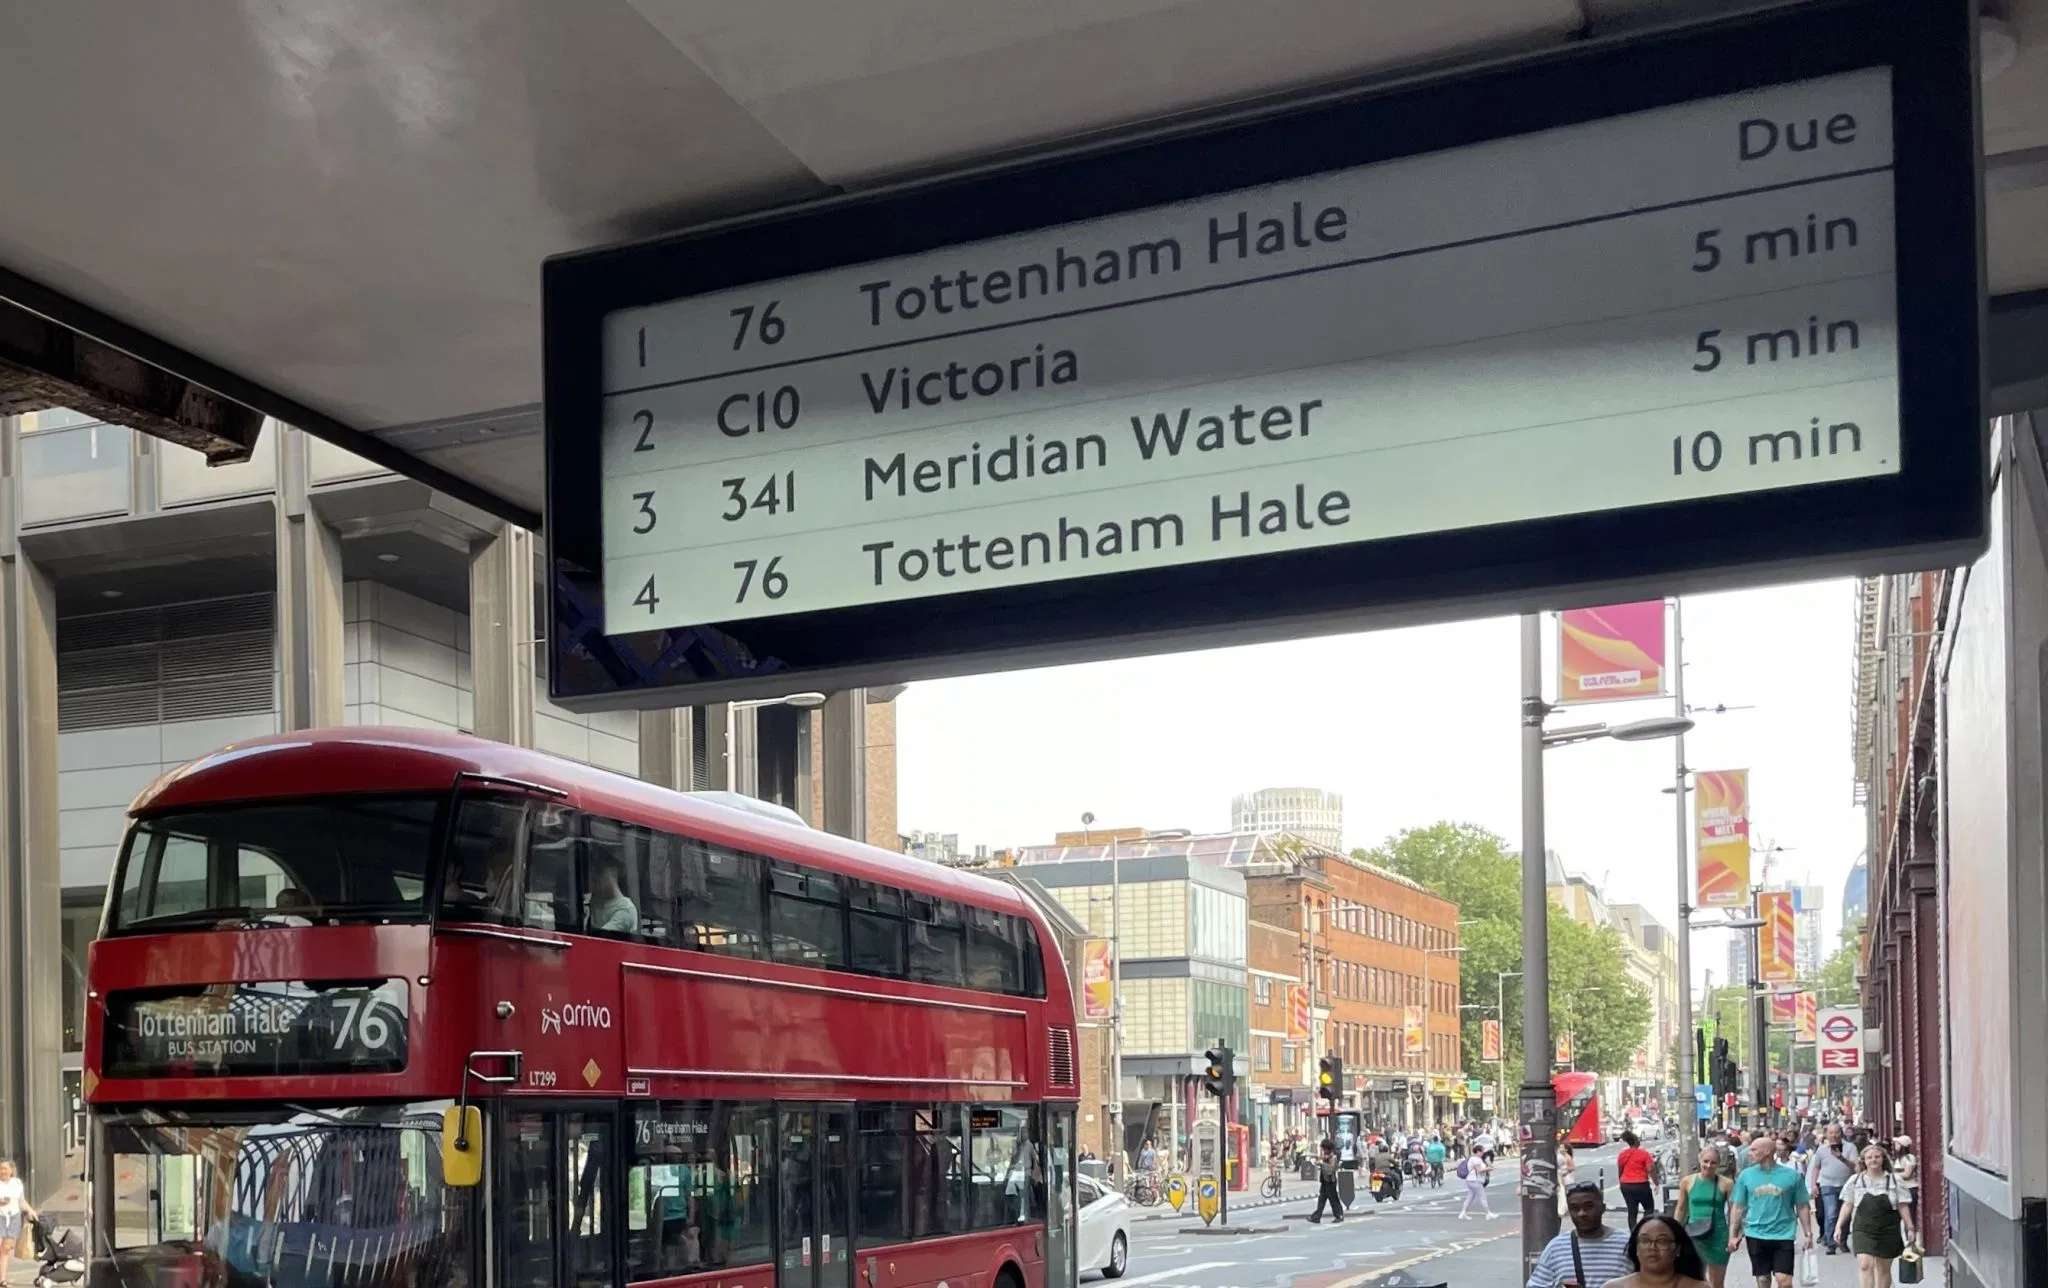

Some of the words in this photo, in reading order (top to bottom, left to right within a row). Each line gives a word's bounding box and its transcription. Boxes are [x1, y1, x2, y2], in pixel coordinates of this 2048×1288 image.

[637, 327, 647, 369] 1
[730, 301, 786, 351] 76
[859, 238, 1183, 327] Tottenham
[1208, 202, 1348, 264] Hale
[1738, 112, 1857, 162] Due
[632, 409, 657, 453] 2
[716, 385, 801, 438] C10
[859, 343, 1080, 415] Victoria
[1690, 228, 1722, 273] 5
[1745, 212, 1858, 265] min
[632, 490, 657, 535] 3
[721, 469, 796, 522] 341
[864, 433, 1108, 502] Meridian
[1130, 399, 1323, 461] Water
[1691, 328, 1722, 373] 5
[1746, 315, 1860, 366] min
[632, 572, 660, 615] 4
[733, 555, 789, 604] 76
[861, 513, 1185, 586] Tottenham
[1210, 483, 1351, 541] Hale
[1672, 430, 1723, 476] 10
[1748, 416, 1862, 466] min
[134, 1005, 237, 1038] Tottenham
[244, 1005, 291, 1034] Hale
[331, 996, 389, 1050] 76
[562, 999, 611, 1028] arriva
[168, 1039, 195, 1056] BUS
[199, 1039, 256, 1055] STATION
[529, 1071, 557, 1087] LT299
[635, 1120, 651, 1144] 76
[652, 1120, 691, 1134] Tottenham
[692, 1120, 708, 1134] Hale
